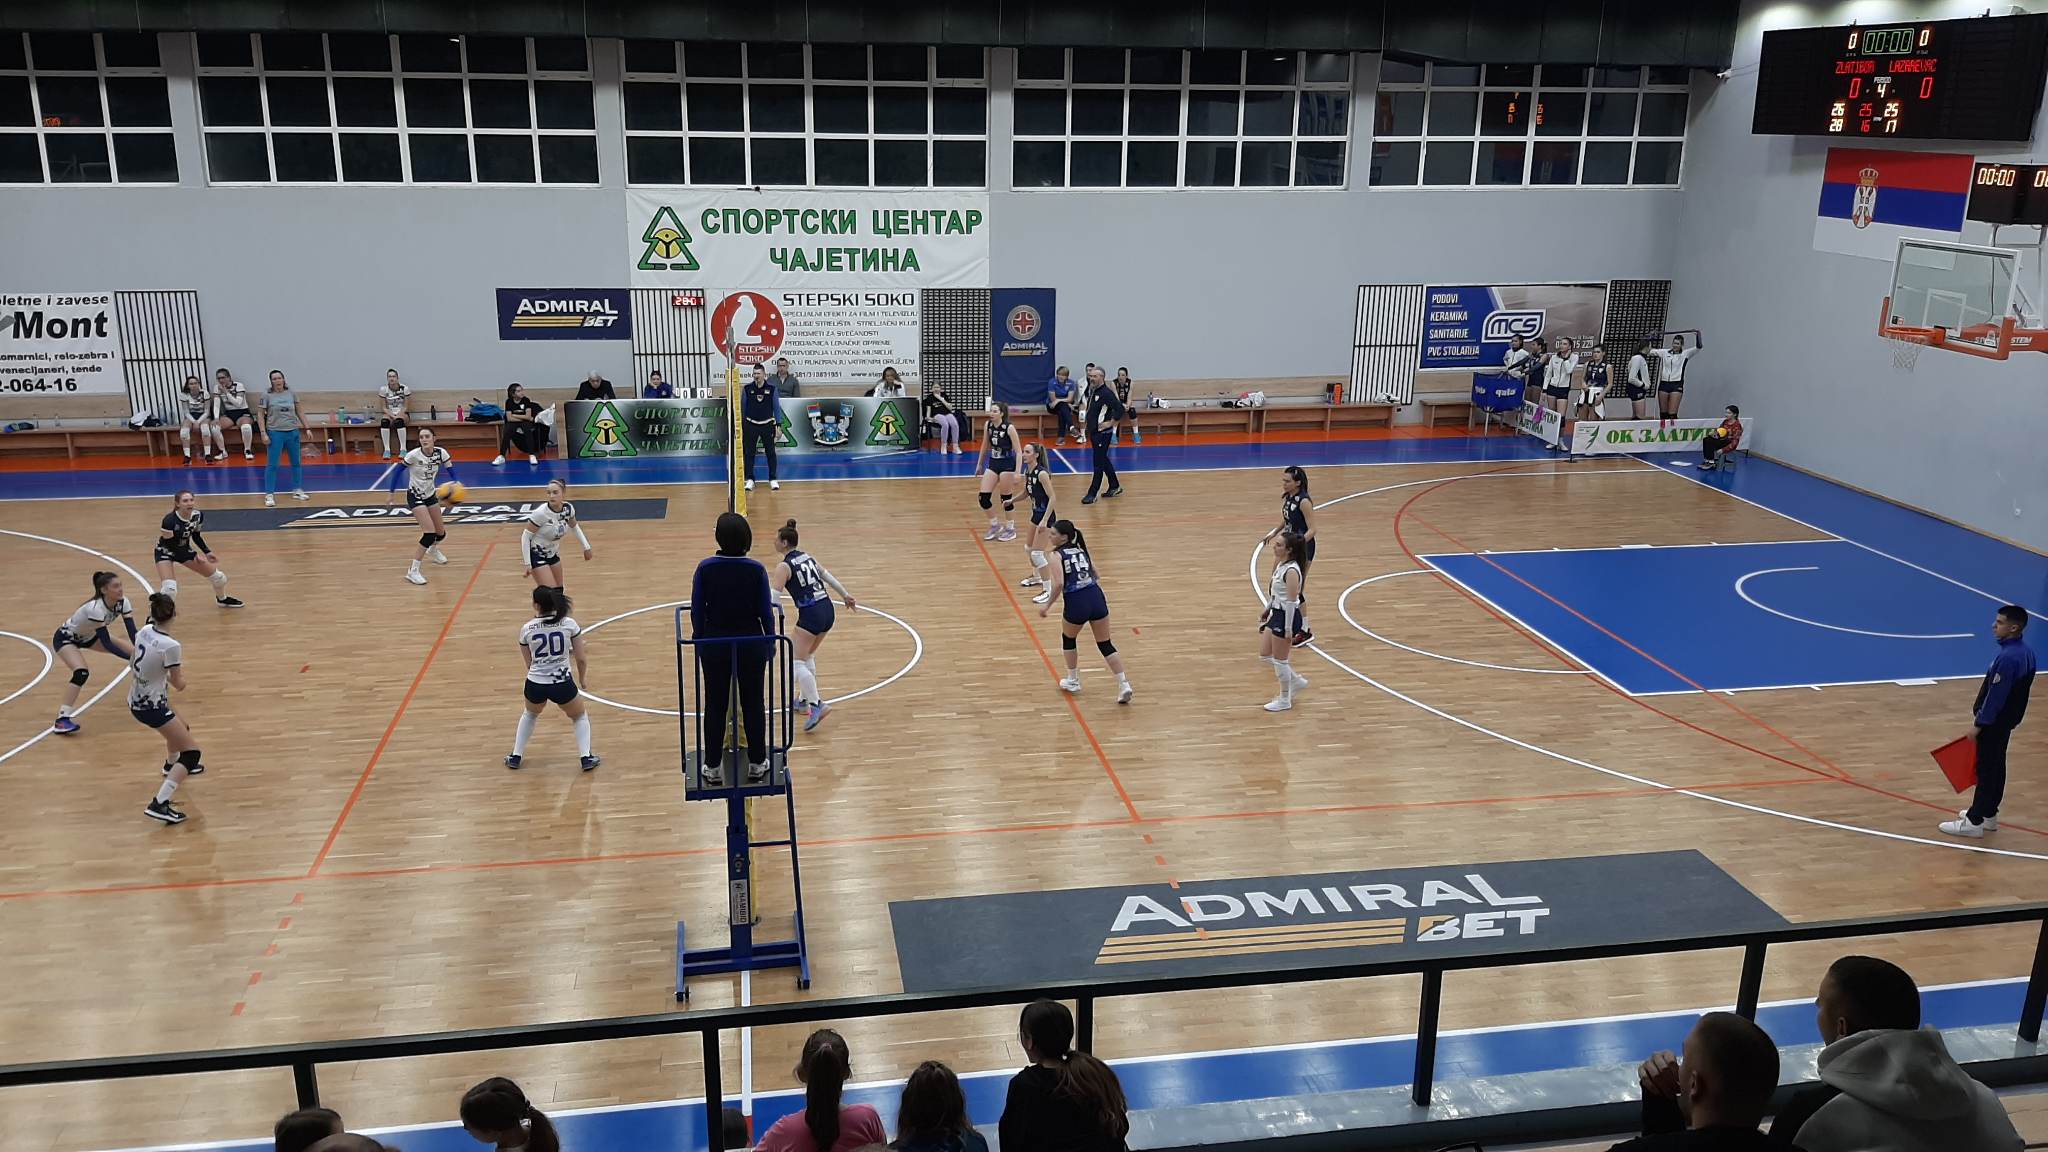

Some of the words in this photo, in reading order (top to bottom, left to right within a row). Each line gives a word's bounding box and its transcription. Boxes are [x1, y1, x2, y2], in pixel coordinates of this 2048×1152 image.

[1848, 33, 1857, 49] 0
[1919, 29, 1930, 47] 0
[1849, 78, 1861, 98] 0
[1877, 83, 1887, 98] 4
[1920, 77, 1933, 98] 0
[1831, 103, 1846, 116] 26
[1884, 103, 1899, 117] 25
[1829, 118, 1844, 132] 28
[1977, 168, 2016, 187] 00:00
[701, 208, 857, 235] СПОРТСКИ
[872, 209, 983, 238] ЦЕНТАР
[769, 248, 920, 272] ЧАЈЕТИНА
[0, 295, 42, 306] letne
[56, 296, 109, 306] zavese
[516, 298, 619, 315] ADMIRAL
[783, 293, 859, 307] STEPSKI
[864, 293, 915, 306] SOKO
[1432, 294, 1458, 304] PODOVI
[583, 315, 618, 327] BET
[1430, 311, 1468, 321] KERAMIKA
[12, 310, 108, 339] Mont
[1429, 329, 1469, 339] SANITARIJE
[1003, 341, 1049, 350] ADMIRAL
[1427, 347, 1442, 357] PVC
[1443, 346, 1480, 356] STOLARIJA
[1606, 429, 1633, 444] ОК
[304, 503, 536, 519] ADMRAL
[1071, 553, 1089, 571] 14
[800, 560, 821, 585] 21
[532, 632, 565, 658] 20
[134, 644, 146, 672] 2
[1110, 873, 1544, 932] ADMIRAL
[1417, 908, 1550, 942] BET
